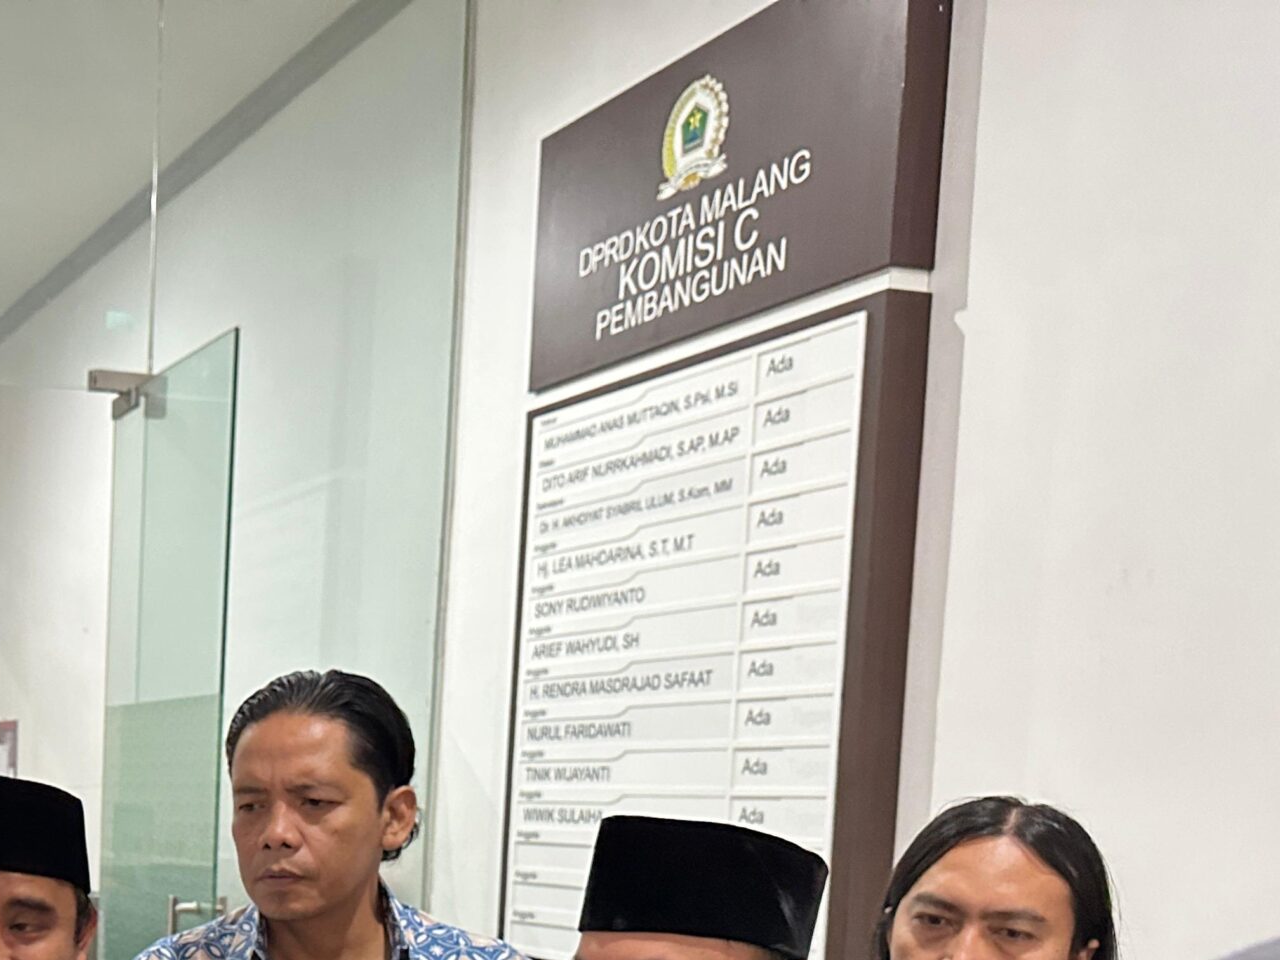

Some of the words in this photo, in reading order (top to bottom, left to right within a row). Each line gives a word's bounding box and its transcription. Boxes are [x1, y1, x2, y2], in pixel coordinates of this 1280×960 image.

[700, 149, 811, 223] MALANG
[618, 220, 724, 299] KOMISI
[734, 207, 759, 252] C
[595, 236, 787, 341] PEMBANGUNAN
[767, 354, 793, 376] Ada
[763, 408, 790, 427] Ada
[760, 458, 787, 477] Ada
[757, 509, 783, 528] Ada
[552, 556, 572, 575] LEA
[754, 560, 780, 578] Ada
[535, 600, 565, 618] SONY
[751, 610, 777, 628] Ada
[531, 642, 562, 660] ARIEF
[622, 633, 639, 650] SH
[748, 659, 774, 677] Ada
[542, 680, 587, 699] RENDRA
[664, 669, 713, 690] SAFAAT
[745, 709, 771, 726] Ada
[527, 725, 562, 741] NURUL
[564, 721, 632, 740] FARIDAWATI
[525, 767, 550, 782] TINIK
[741, 758, 767, 776] Ada
[522, 808, 555, 823] WIWIK
[738, 807, 764, 825] Ada
